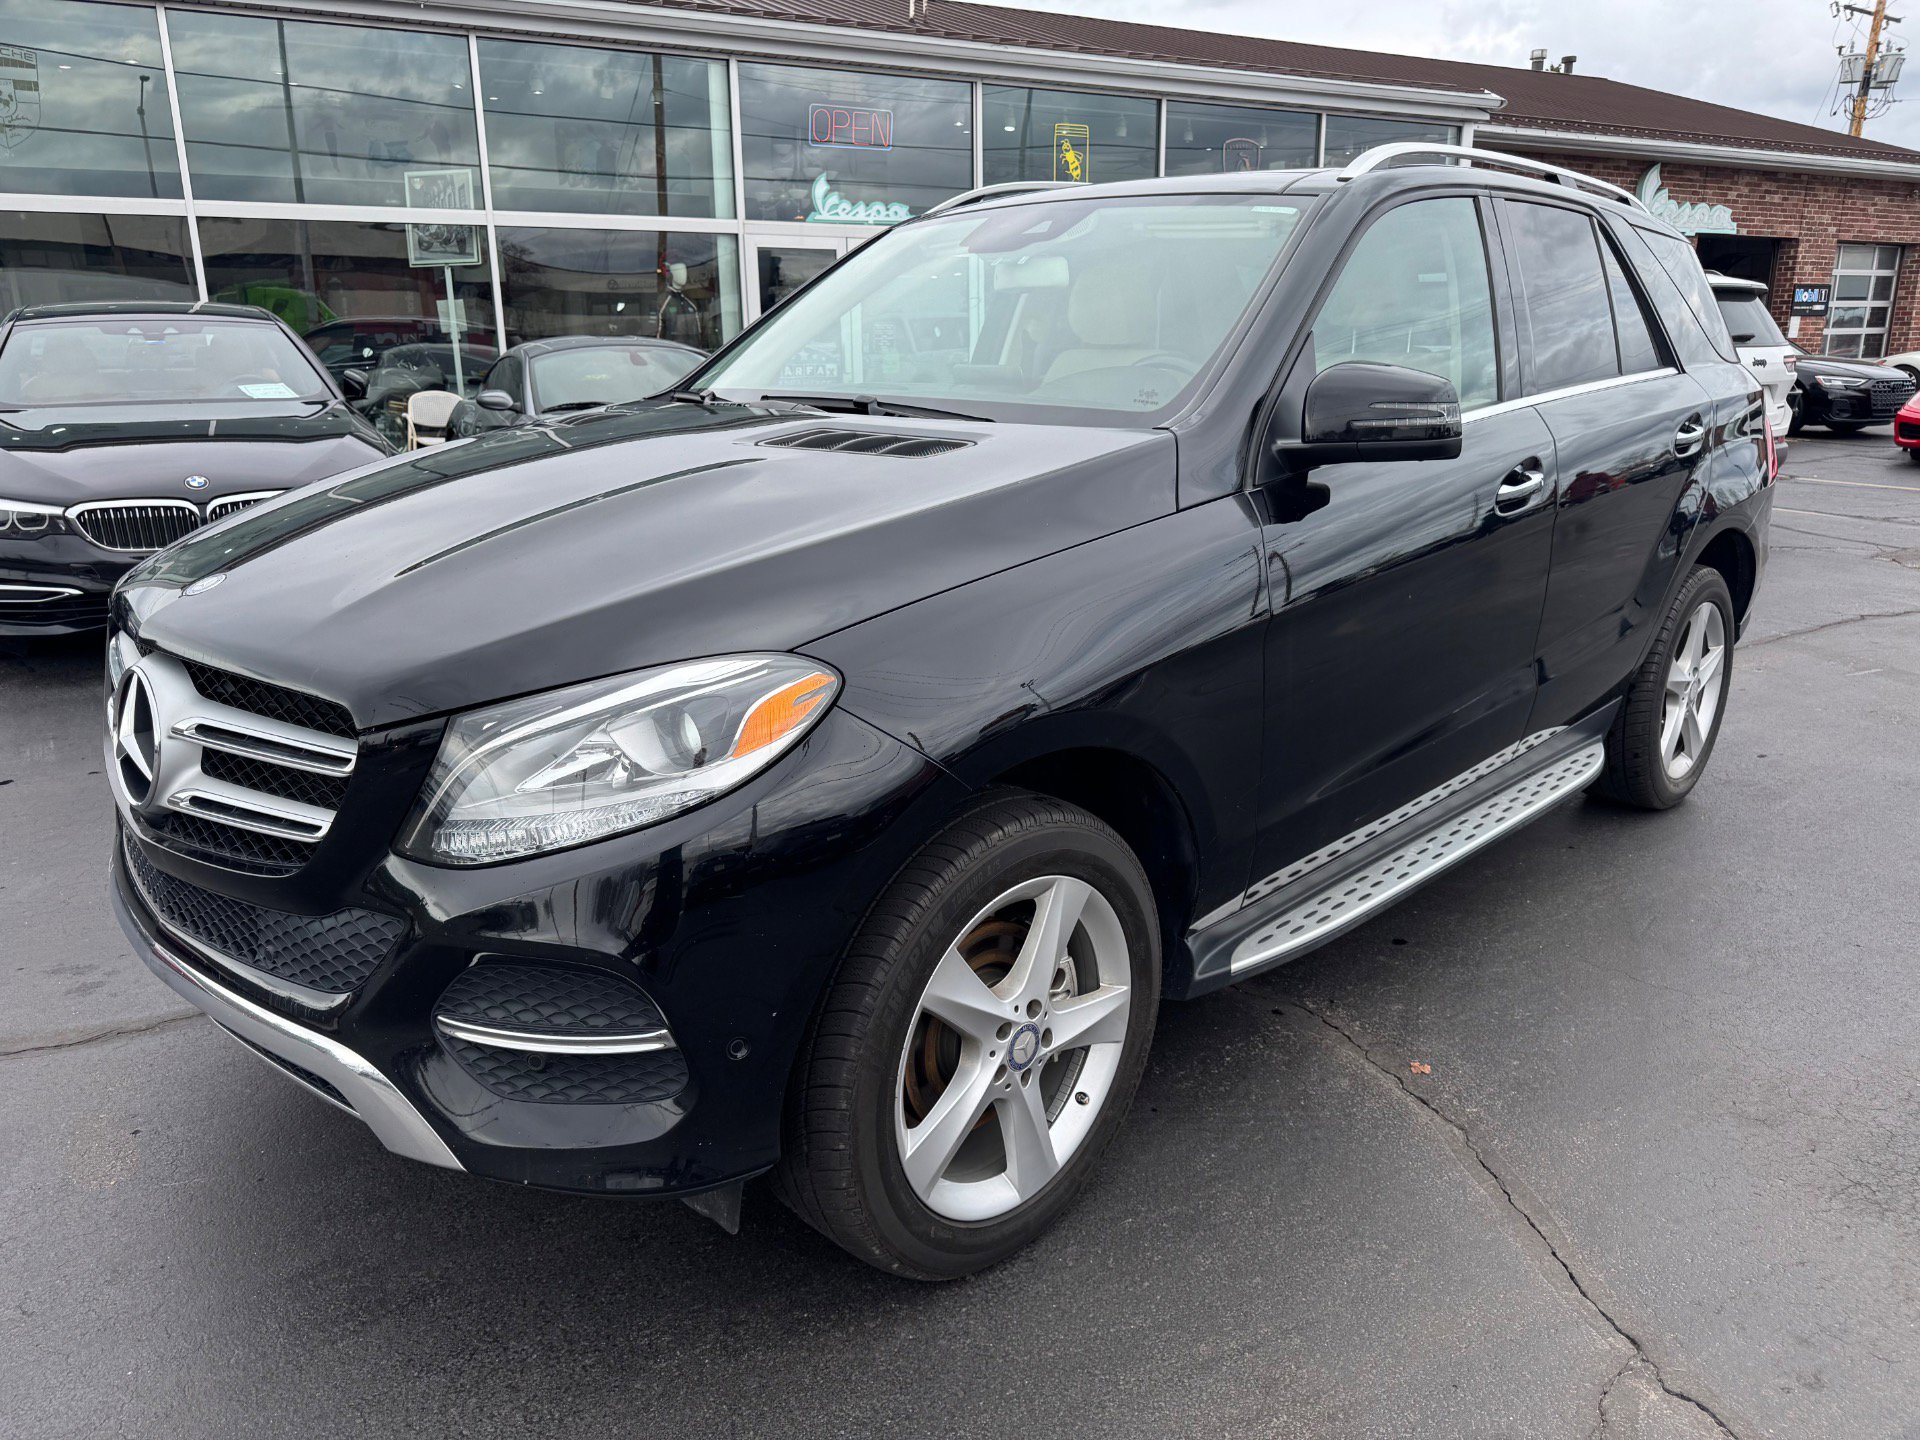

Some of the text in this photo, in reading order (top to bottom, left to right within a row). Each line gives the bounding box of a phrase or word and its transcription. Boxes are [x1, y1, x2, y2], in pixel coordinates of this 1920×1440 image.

[812, 108, 890, 147] OPEN
[811, 171, 914, 223] Vespa
[1640, 163, 1736, 234] Vespa
[1795, 289, 1827, 302] Mobil 1
[780, 364, 837, 377] ARFAX
